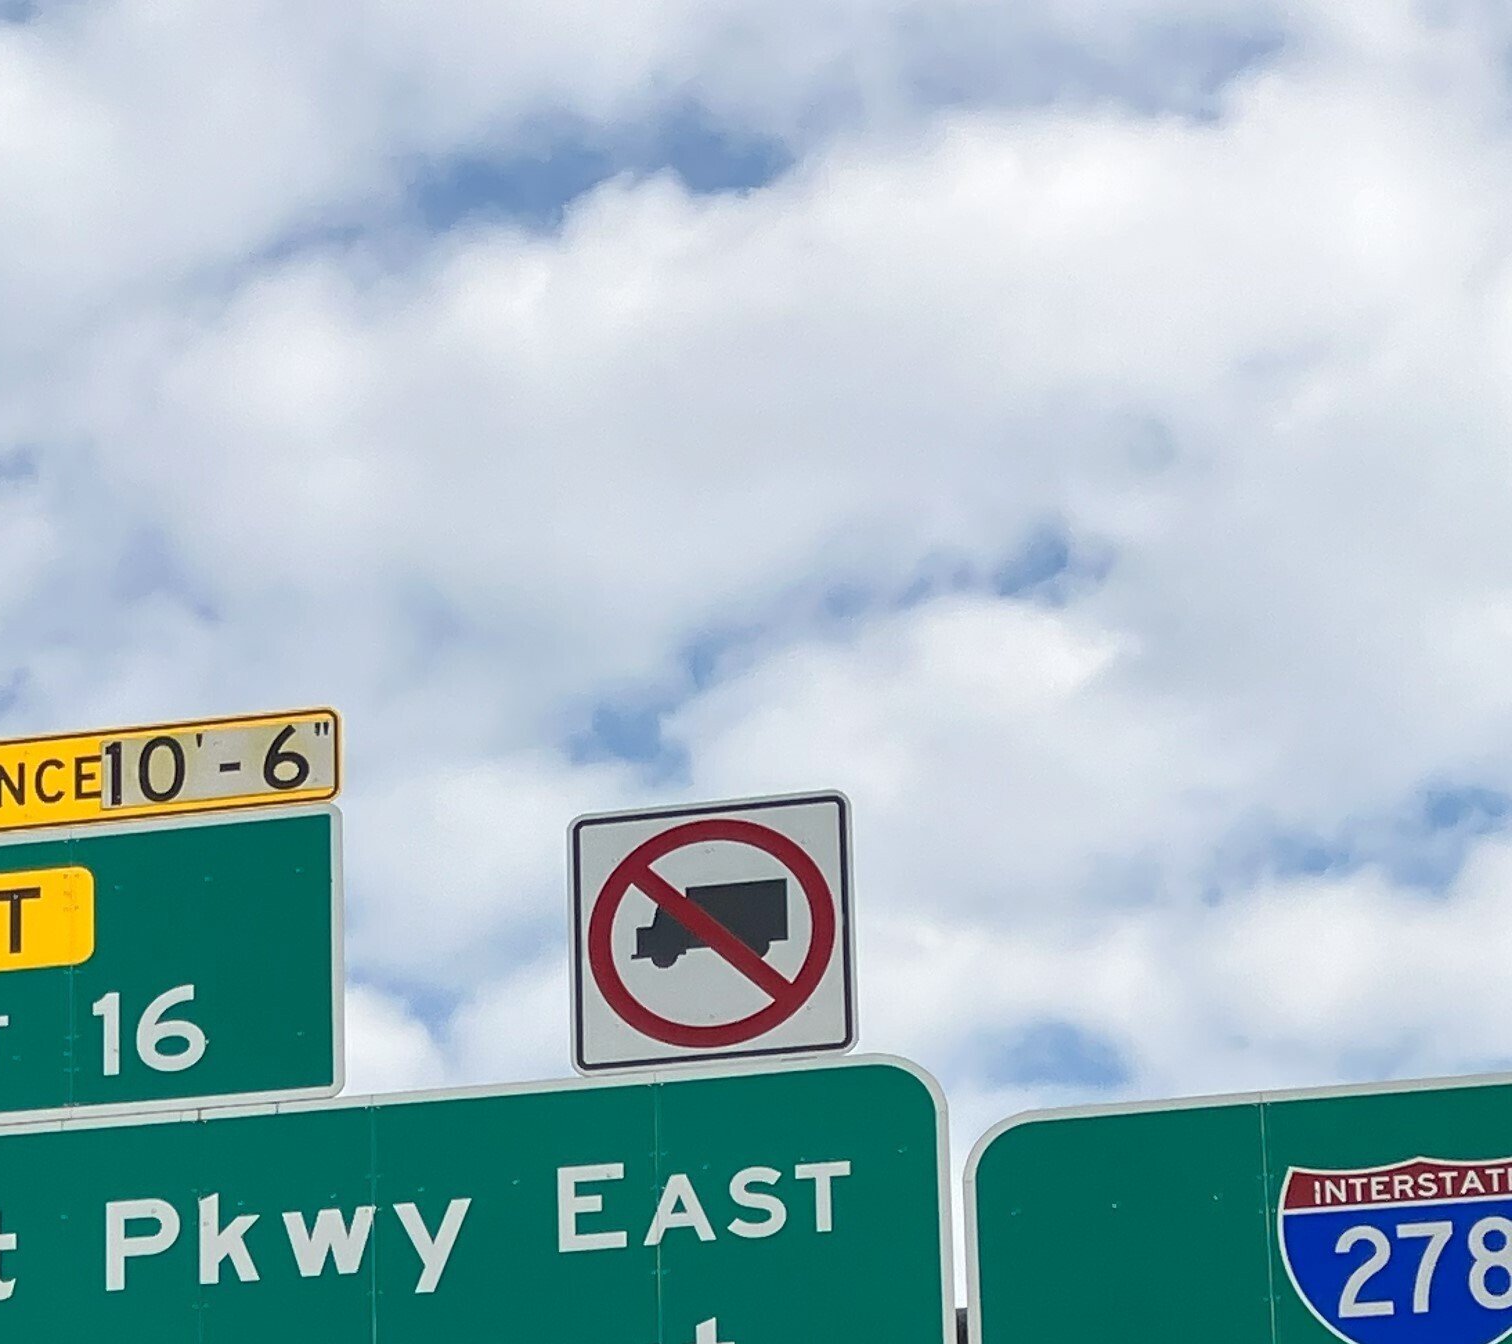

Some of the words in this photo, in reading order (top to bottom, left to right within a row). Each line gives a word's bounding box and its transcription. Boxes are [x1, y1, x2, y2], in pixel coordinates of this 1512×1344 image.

[93, 984, 207, 1076] 16
[105, 1193, 471, 1292] Pkwy
[557, 1161, 850, 1252] EAST
[1335, 1216, 1512, 1318] 278
